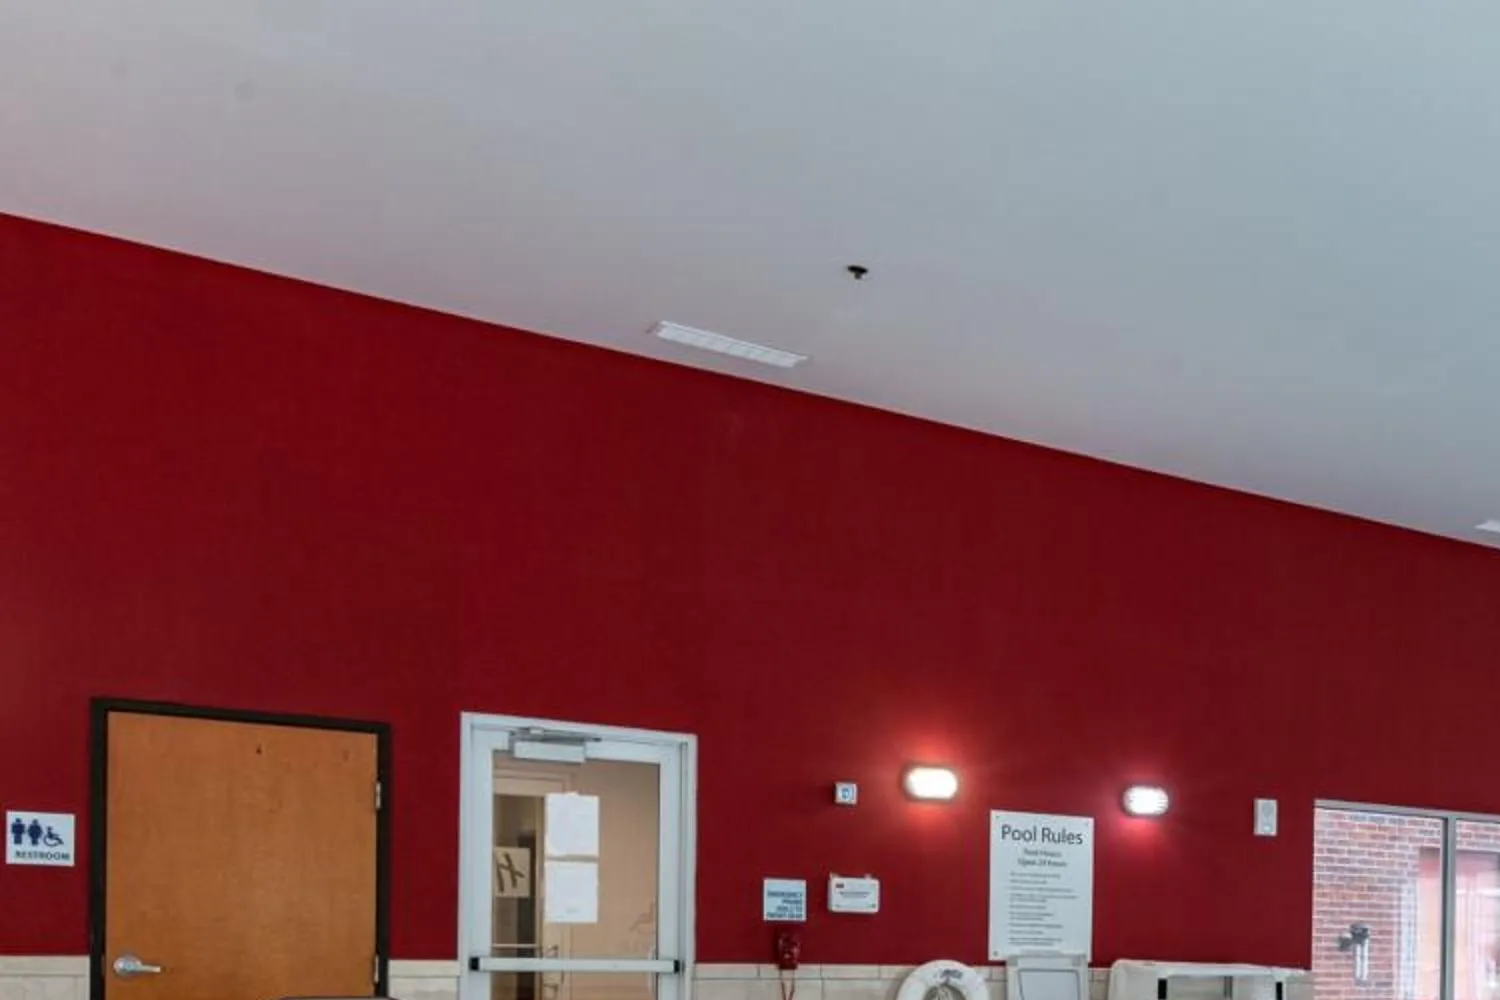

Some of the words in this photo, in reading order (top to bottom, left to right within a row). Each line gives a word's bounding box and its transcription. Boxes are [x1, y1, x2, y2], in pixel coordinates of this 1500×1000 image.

[1001, 824, 1037, 842] Pool
[1041, 827, 1083, 845] Rules
[15, 850, 70, 861] RESTROOM
